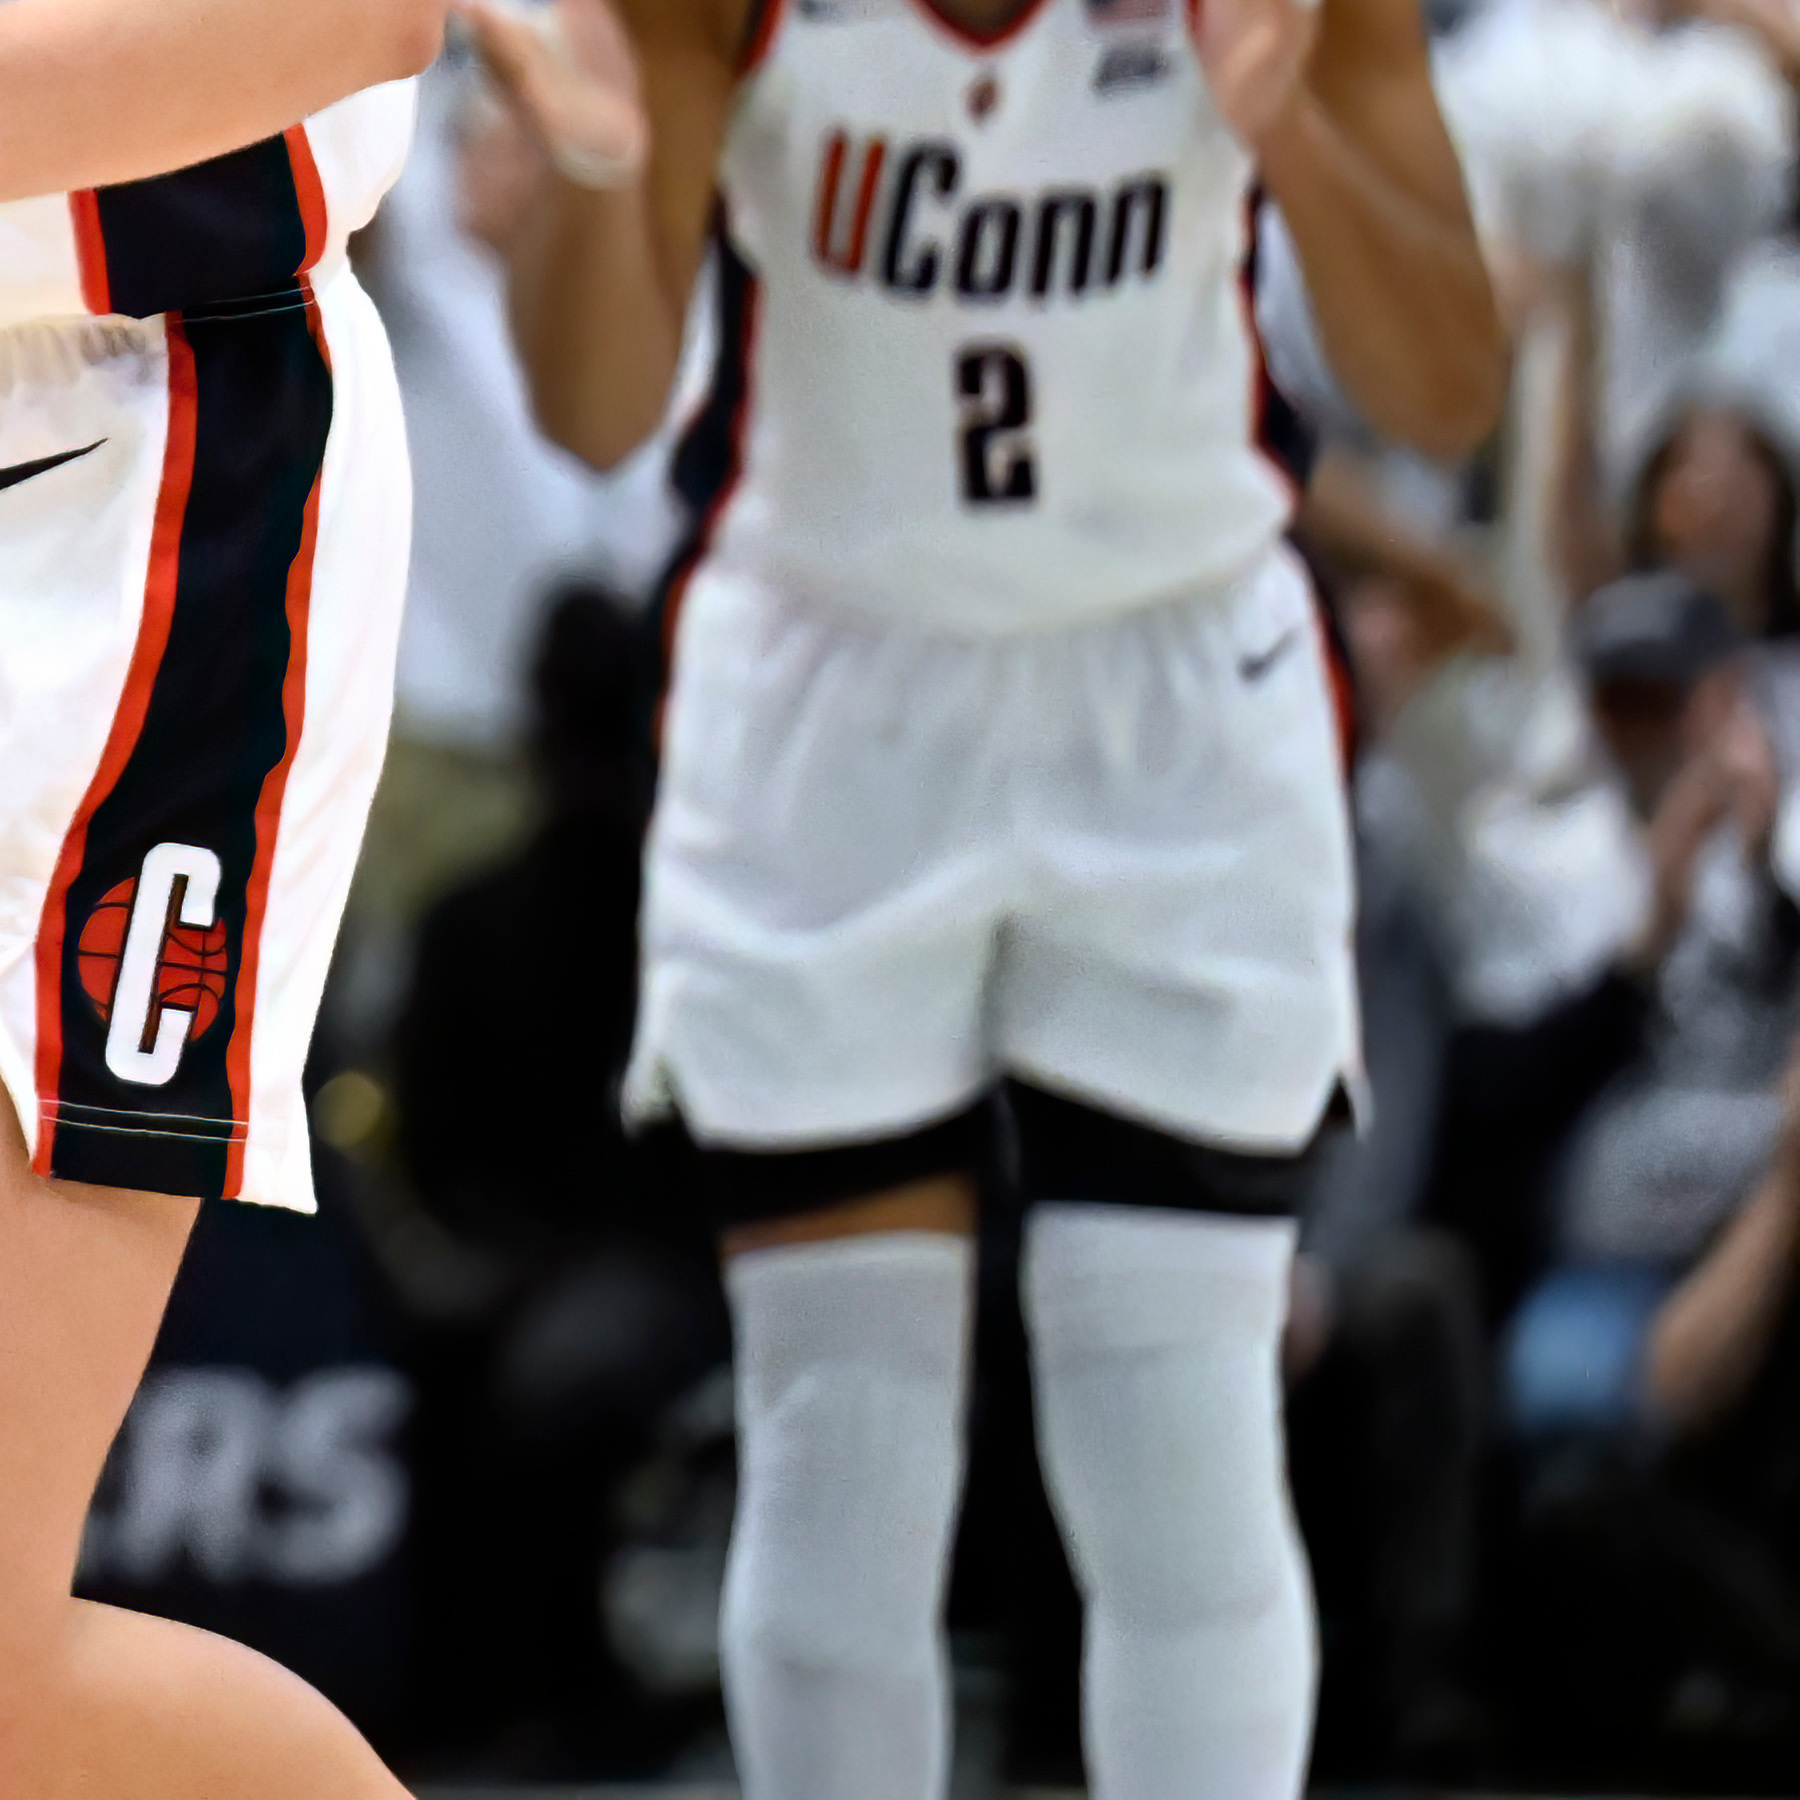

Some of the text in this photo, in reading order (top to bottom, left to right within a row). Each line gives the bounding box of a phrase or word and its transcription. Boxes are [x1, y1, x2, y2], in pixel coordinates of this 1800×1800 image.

[811, 128, 1170, 304] UConn
[954, 341, 1037, 508] 2
[105, 842, 222, 1086] C
